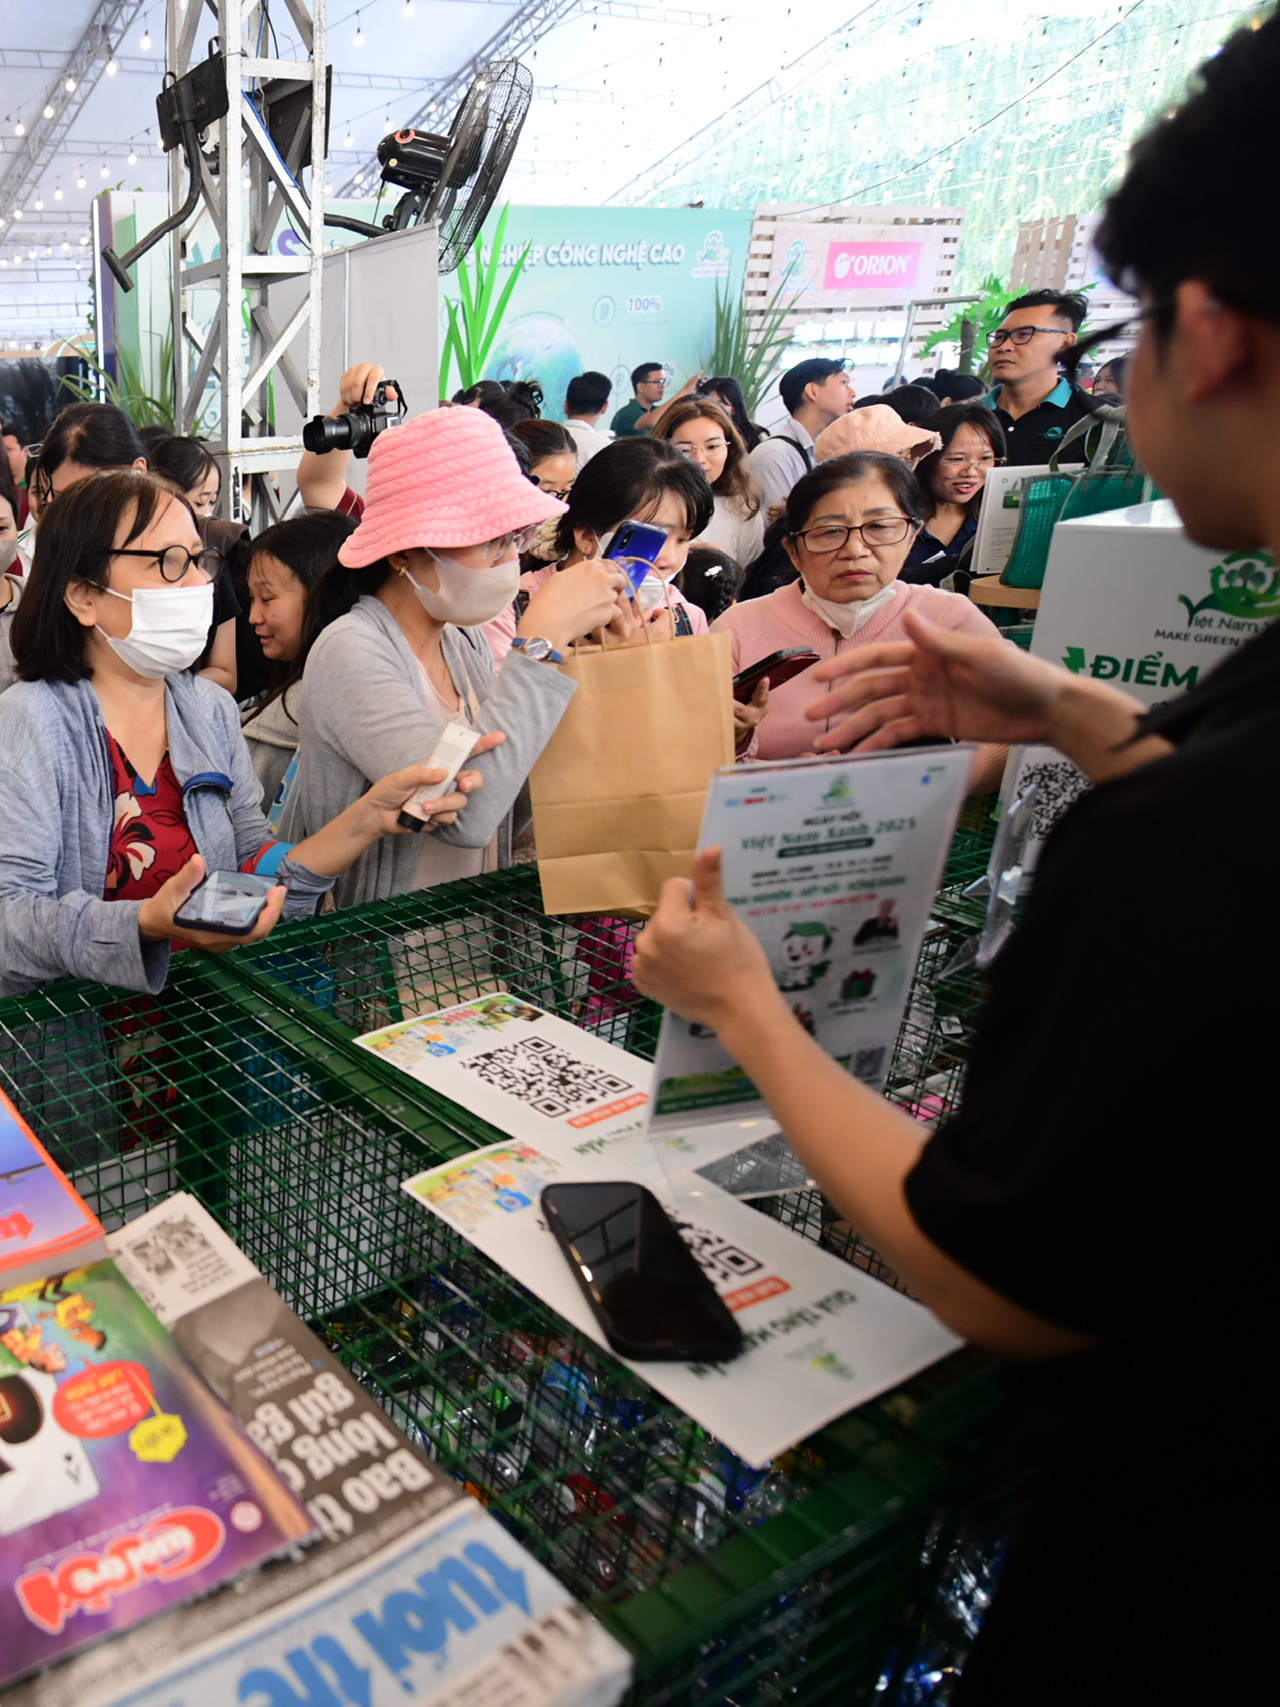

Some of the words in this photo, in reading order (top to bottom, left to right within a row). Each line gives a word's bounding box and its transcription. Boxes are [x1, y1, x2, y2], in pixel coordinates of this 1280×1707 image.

[545, 239, 599, 266] CÔNG
[599, 239, 648, 271] NGHỆ
[648, 242, 686, 266] CAO
[853, 254, 908, 276] ORION
[627, 296, 662, 312] 100%
[1217, 617, 1259, 633] Nam
[1154, 629, 1191, 642] MAKE
[1194, 634, 1240, 647] GREEN
[1089, 651, 1200, 691] ĐIỂM
[741, 833, 774, 851] Việt
[780, 829, 819, 846] Nam
[825, 822, 868, 840] Xanh
[337, 1446, 436, 1518] Bao
